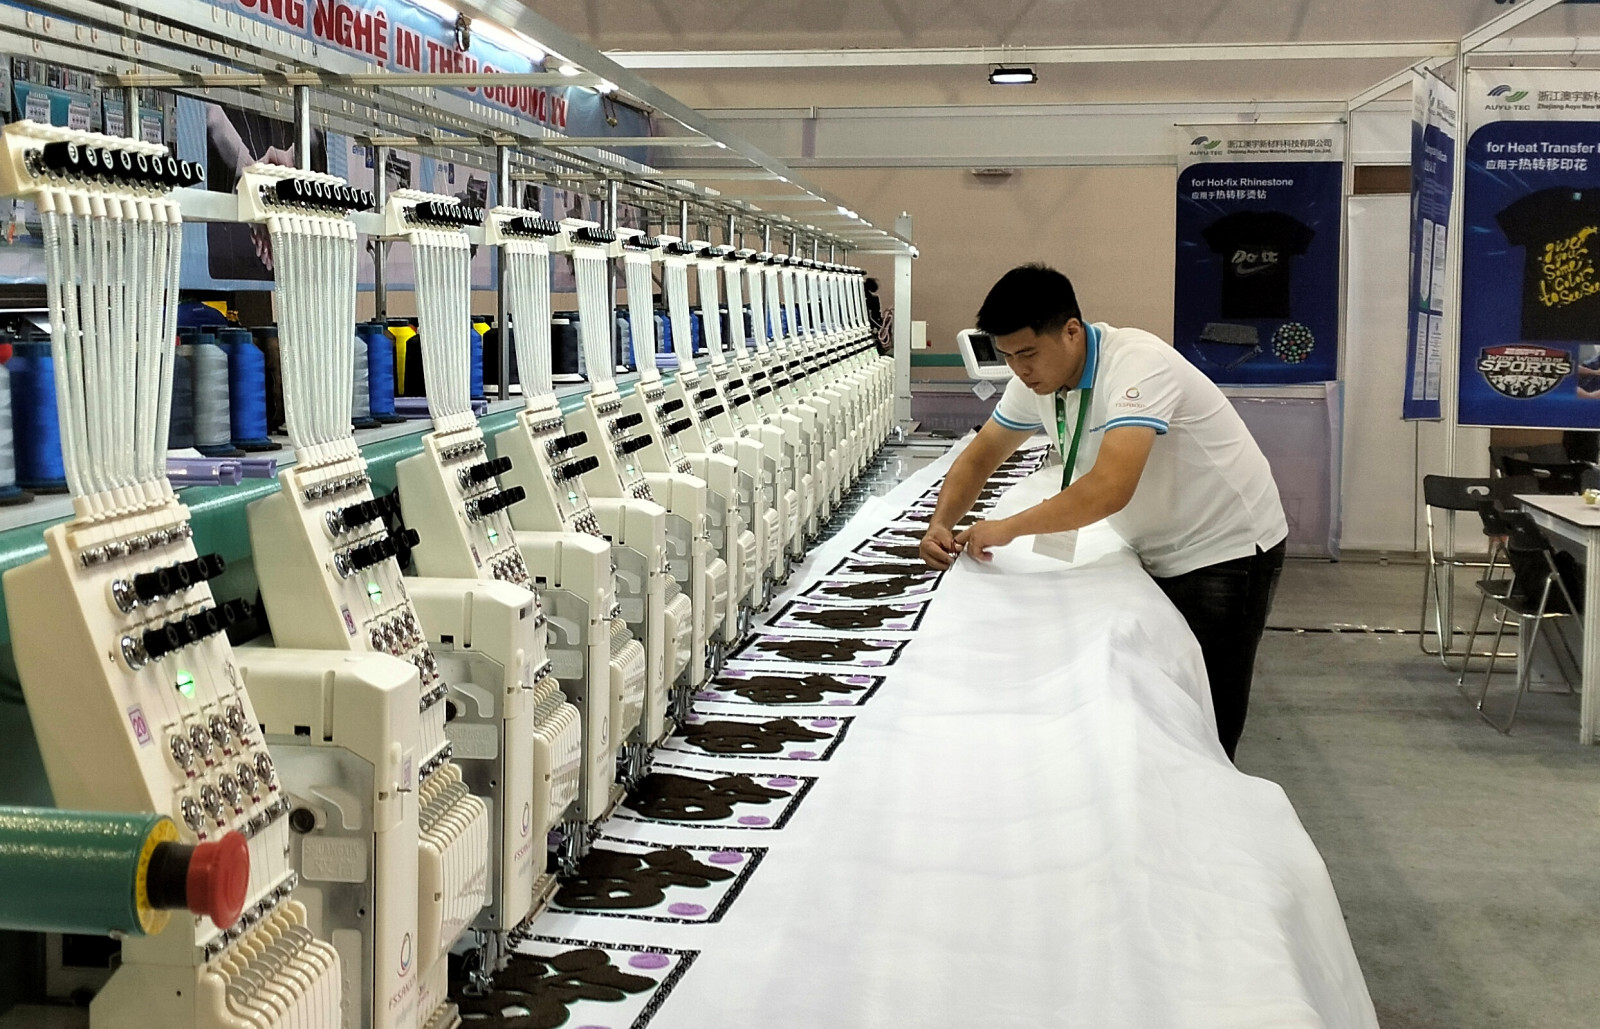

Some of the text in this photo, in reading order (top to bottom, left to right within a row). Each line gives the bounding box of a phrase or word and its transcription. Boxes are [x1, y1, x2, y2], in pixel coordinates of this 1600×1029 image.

[313, 0, 388, 67] NGHỆ
[396, 26, 420, 72] IN
[1486, 141, 1505, 153] for
[1508, 142, 1538, 153] Heat
[1541, 142, 1595, 153] Transfer
[1485, 158, 1588, 171] 应用于热转移印花
[1191, 178, 1294, 187] for Hot-fix Rhinestone
[1504, 347, 1546, 356] ESPN
[1487, 354, 1515, 362] WIDE
[1515, 355, 1552, 363] WORLD
[1479, 360, 1571, 375] SPORTS
